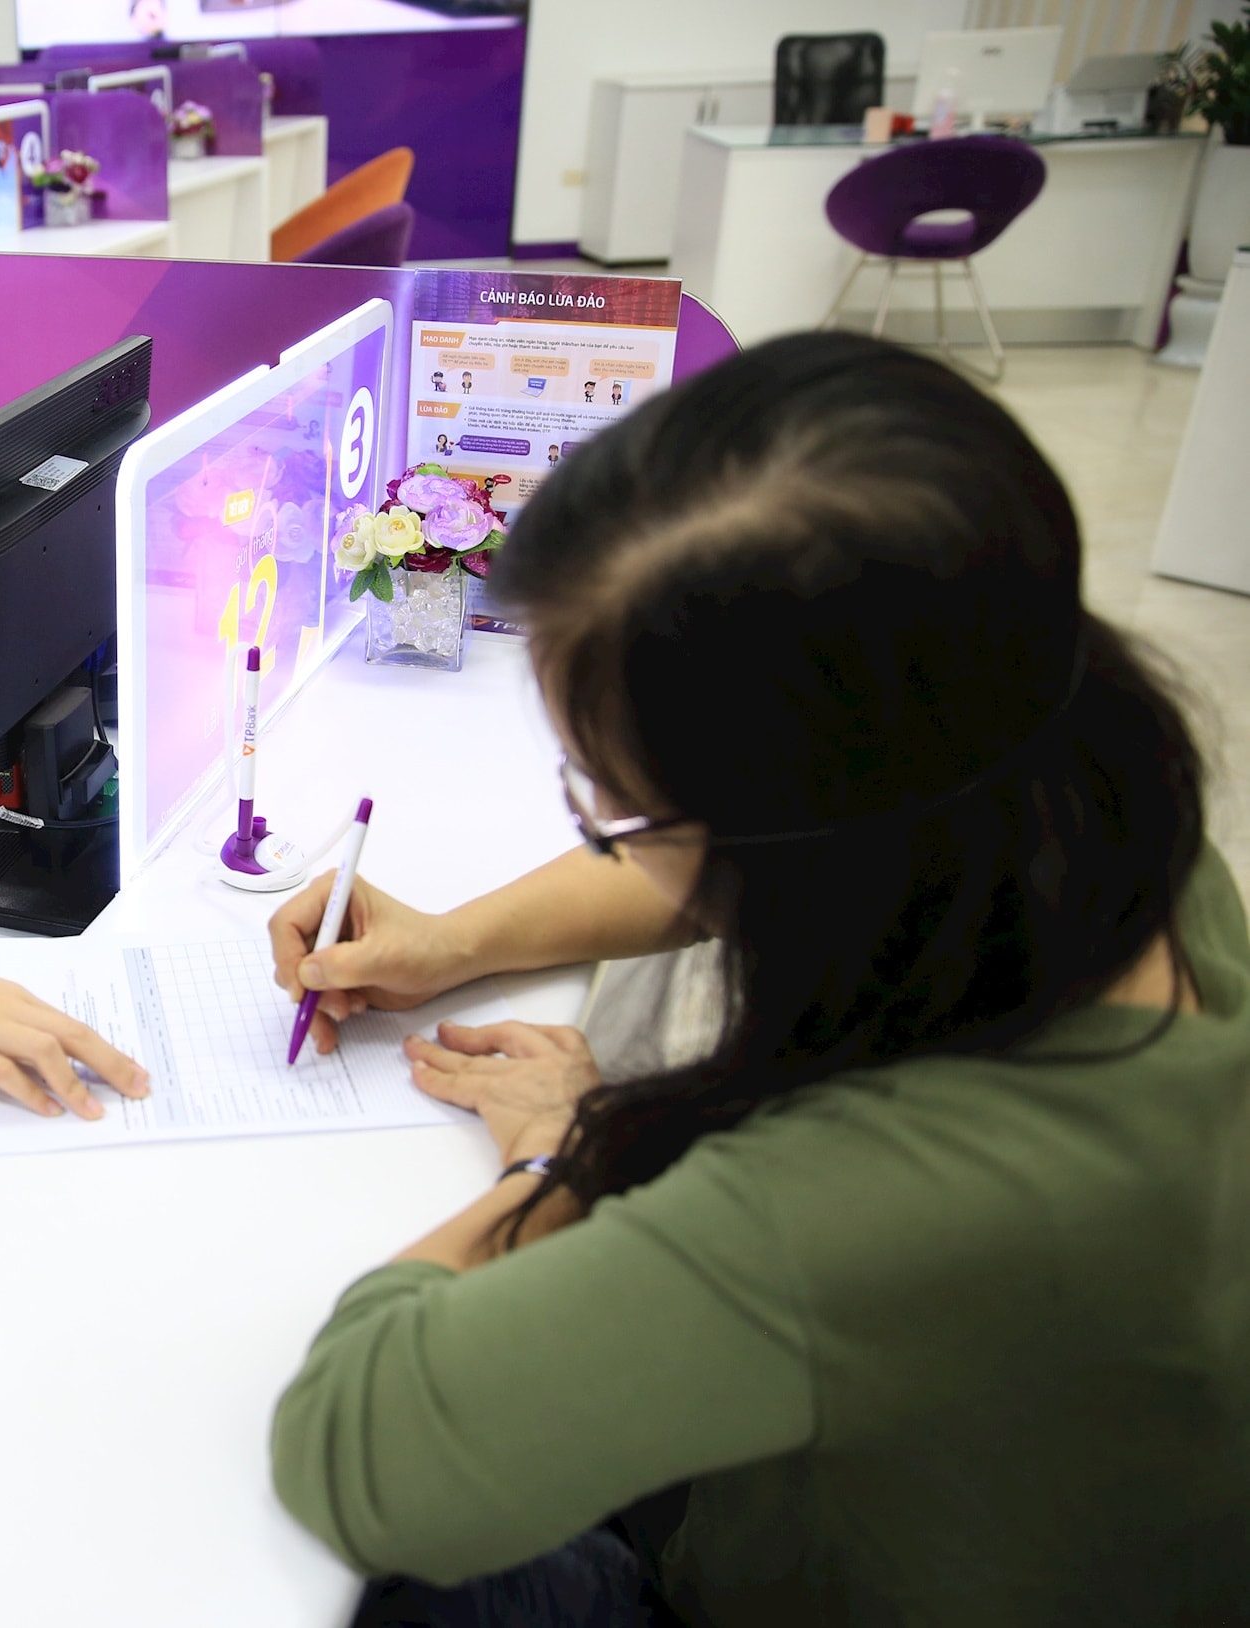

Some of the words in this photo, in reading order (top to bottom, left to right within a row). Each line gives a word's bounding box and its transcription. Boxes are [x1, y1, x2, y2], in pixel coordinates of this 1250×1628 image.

[479, 287, 516, 304] CẢNH
[518, 290, 545, 306] BÁO
[548, 291, 574, 307] LỪA
[577, 292, 605, 309] ĐẢO
[348, 405, 366, 484] 3
[217, 552, 278, 710] 12
[244, 704, 257, 743] TPBank
